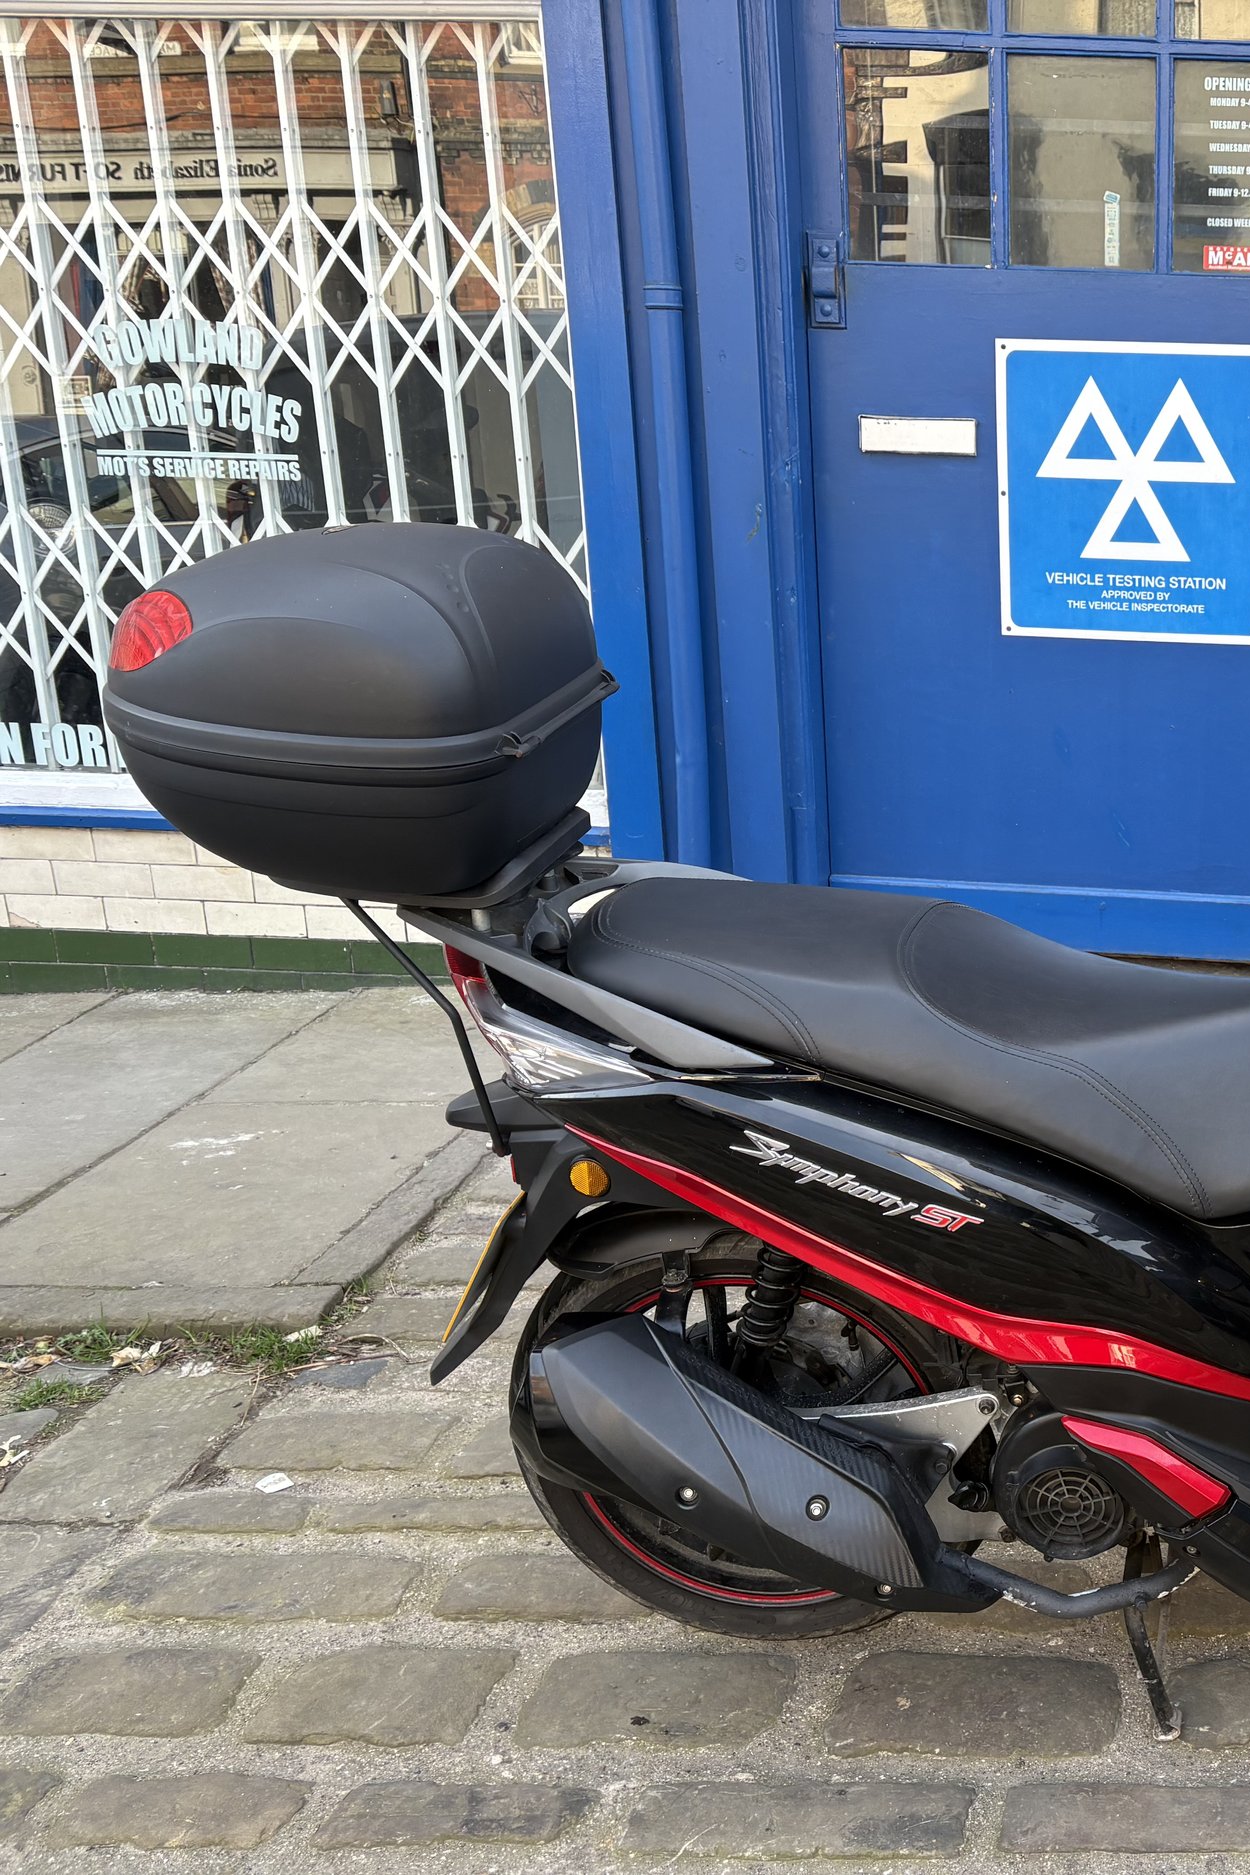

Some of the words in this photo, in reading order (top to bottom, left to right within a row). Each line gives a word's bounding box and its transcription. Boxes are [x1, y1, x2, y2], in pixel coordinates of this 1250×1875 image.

[1210, 97, 1239, 107] MONDAY
[1210, 120, 1240, 130] TUESDAY
[1209, 142, 1250, 153] WEDNESDAY
[1208, 165, 1245, 175] THURSDAY
[1208, 187, 1232, 197] FRIDAY
[1206, 217, 1233, 228] CLOSED
[93, 318, 264, 371] GOWLAND
[81, 382, 188, 439] MOTOR
[191, 382, 302, 443] CYCLES
[154, 457, 225, 479] SERVICE
[228, 459, 302, 481] REPAIRS
[1045, 571, 1103, 586] VEHICLE
[1107, 574, 1165, 588] TESTING
[1169, 576, 1226, 590] STATION
[1100, 590, 1154, 600] APPROVED
[1157, 592, 1170, 601] BY
[1067, 600, 1086, 609] THE
[1088, 601, 1129, 611] VEHICLE
[1131, 602, 1205, 614] INSPECTORATE
[30, 722, 108, 768] FOR
[729, 1129, 919, 1217] Symphony
[910, 1204, 985, 1233] ST
